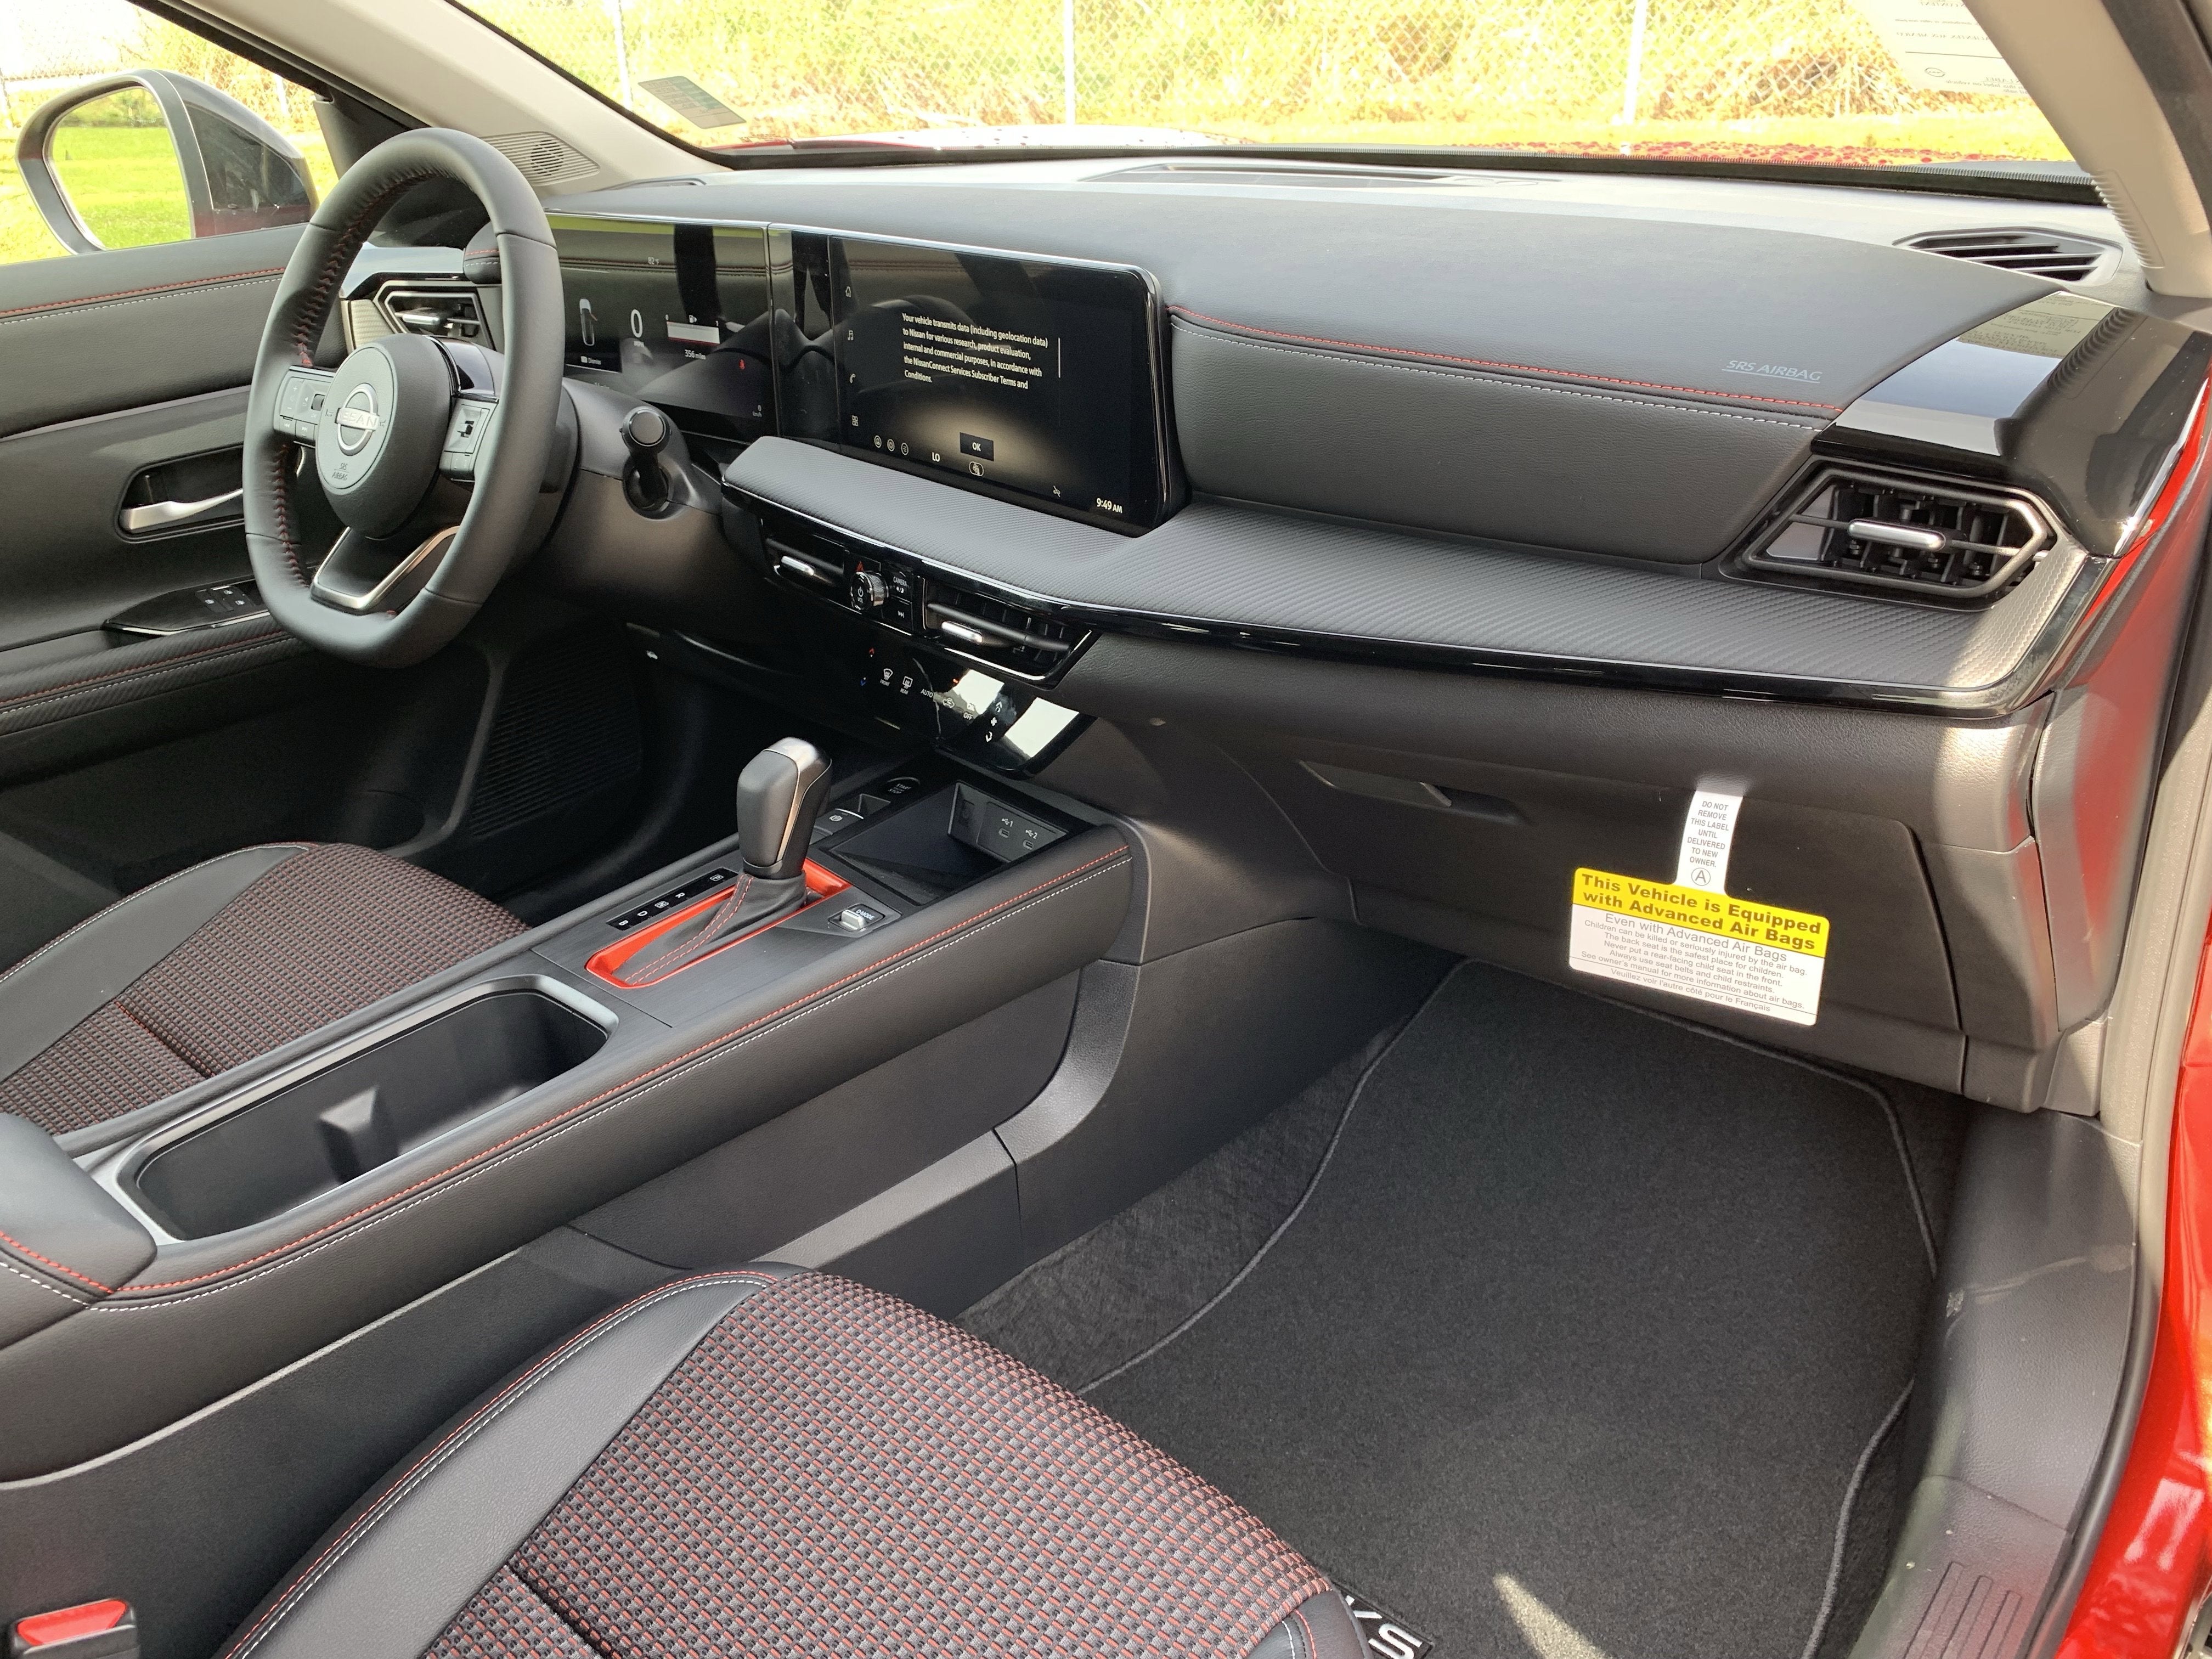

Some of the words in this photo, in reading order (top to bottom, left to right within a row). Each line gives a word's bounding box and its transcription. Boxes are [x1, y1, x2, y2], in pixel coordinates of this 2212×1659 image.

[631, 309, 643, 338] 0
[902, 313, 915, 323] Your
[915, 315, 932, 326] vehicle
[933, 319, 957, 331] transmits
[957, 323, 969, 332] data
[970, 324, 997, 340] (including
[998, 331, 1031, 344] geolocation
[1032, 336, 1048, 348] data)
[902, 328, 909, 336] to
[909, 328, 926, 338] Nissan
[934, 334, 953, 345] various
[953, 338, 977, 350] research,
[978, 342, 1000, 353] product
[1000, 347, 1031, 361] evaluation,
[924, 346, 934, 355] and
[934, 349, 964, 361] commercial
[964, 354, 990, 368] purposes,
[997, 362, 1028, 374] accordance
[1029, 366, 1042, 377] with
[1726, 360, 1757, 371] SRS
[1757, 364, 1822, 381] AIRBAG
[904, 355, 913, 365] the
[913, 357, 950, 373] NissanConnect
[951, 365, 971, 377] Services
[971, 370, 1000, 383] Subscriber
[1000, 376, 1017, 387] Terms
[1017, 380, 1029, 390] and
[904, 369, 933, 383] Conditions.
[932, 452, 940, 462] LO
[972, 442, 982, 452] OK
[1096, 498, 1112, 511] 9:49
[1113, 504, 1122, 514] AM
[893, 576, 907, 587] CAMERA
[921, 689, 934, 698] AUTO
[963, 712, 973, 721] OFF
[1697, 809, 1727, 821] REMOVE
[1702, 800, 1712, 809] DO
[1713, 803, 1729, 811] NOT
[1691, 817, 1706, 827] THIS
[1707, 821, 1729, 831] LABEL
[1698, 829, 1718, 839] UNTIL
[1687, 836, 1725, 850] DELIVERED
[1702, 849, 1718, 858] NEW
[1689, 856, 1717, 867] OWNER.
[1582, 873, 1621, 892] This
[1628, 882, 1698, 908] Vehicle
[1704, 899, 1721, 913] is
[1728, 903, 1821, 934] Equipped
[1583, 891, 1623, 909] with
[1629, 900, 1724, 930] Advanced
[1729, 921, 1759, 937] Air
[1765, 928, 1815, 950] Bags
[1584, 919, 1617, 932] Children
[1635, 930, 1645, 939] be
[1647, 933, 1668, 944] killed
[1680, 942, 1716, 956] seriously
[1718, 949, 1746, 962] injured
[1748, 955, 1758, 966] by
[1760, 958, 1774, 967] the
[1776, 962, 1787, 970] air
[1790, 965, 1808, 976] bag.
[1605, 912, 1635, 928] Even
[1639, 922, 1663, 934] with
[1667, 927, 1729, 949] Advanced
[1732, 940, 1751, 953] Air
[1754, 945, 1787, 962] Bags
[1604, 940, 1627, 951] Never
[1629, 946, 1641, 955] put
[1651, 952, 1694, 967] rear-facing
[1695, 961, 1714, 971] child
[1716, 967, 1734, 976] seat
[1736, 969, 1744, 977] in
[1746, 972, 1759, 981] the
[1761, 975, 1782, 987] front.
[1605, 932, 1622, 941] The
[1622, 935, 1640, 946] back
[1642, 941, 1659, 950] seat
[1670, 946, 1683, 955] the
[1685, 951, 1709, 961] safest
[1711, 957, 1734, 967] place
[1748, 965, 1784, 979] children.
[1581, 951, 1596, 960] See
[1598, 956, 1628, 968] owner's
[1630, 963, 1659, 975] manual
[1661, 969, 1672, 978] for
[1674, 973, 1695, 983] more
[1696, 978, 1741, 995] information
[1743, 989, 1767, 1001] about
[1769, 994, 1780, 1003] air
[1782, 997, 1805, 1009] bags.
[1610, 950, 1637, 962] Always
[1639, 957, 1654, 965] use
[1656, 961, 1673, 970] seat
[1674, 964, 1694, 974] belts
[1696, 970, 1711, 979] and
[1713, 973, 1732, 983] child
[1734, 979, 1775, 994] restraints.
[1611, 968, 1641, 982] Veuillez
[1643, 977, 1658, 985] voir
[1659, 979, 1684, 991] l'autre
[1685, 986, 1703, 996] côté
[1705, 991, 1724, 1001] pour
[1725, 995, 1733, 1003] le
[1735, 998, 1770, 1012] Français
